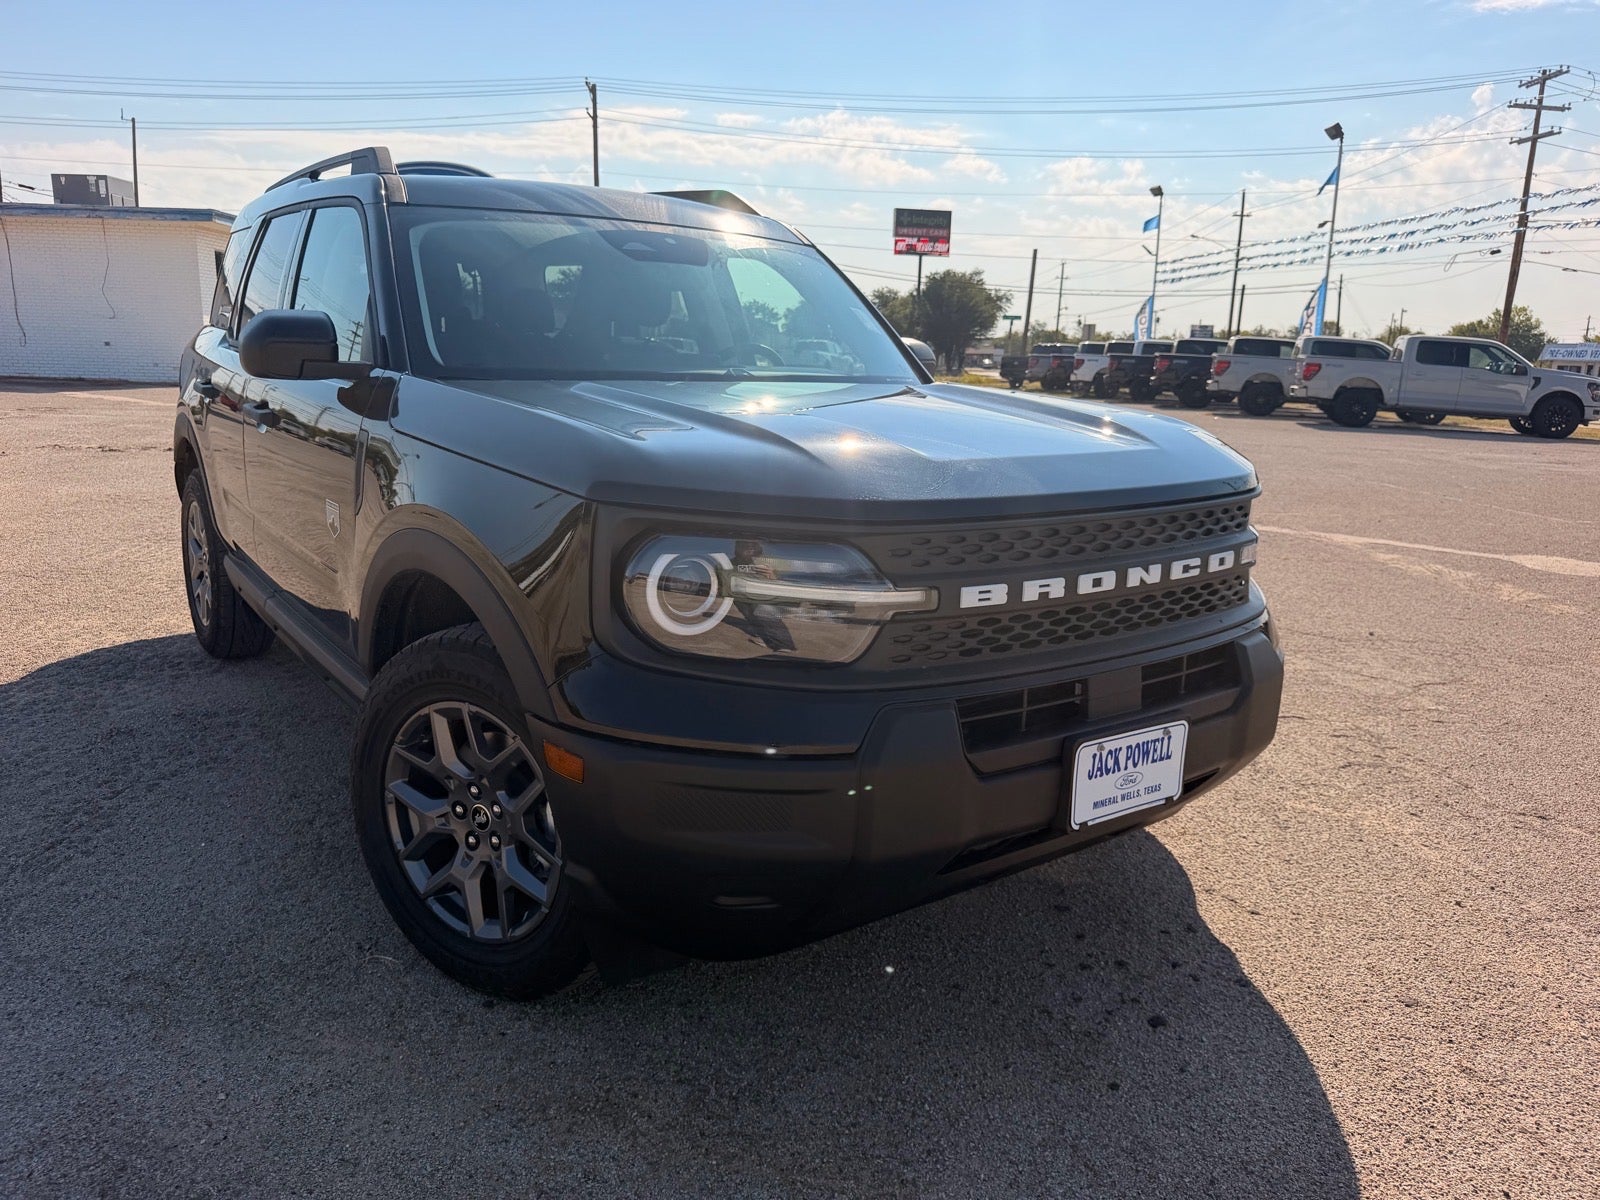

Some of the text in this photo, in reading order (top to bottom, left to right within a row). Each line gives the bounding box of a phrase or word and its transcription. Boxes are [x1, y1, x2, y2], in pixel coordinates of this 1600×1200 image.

[912, 215, 947, 227] Integrity
[898, 227, 949, 237] URGENT CARE
[1546, 349, 1588, 359] PRE-OWNED
[960, 551, 1234, 608] BRONCO
[1087, 735, 1173, 780] JACK POWELL
[1120, 774, 1139, 788] Ford
[1092, 795, 1119, 810] MINERAL
[1144, 783, 1162, 796] TEXAS
